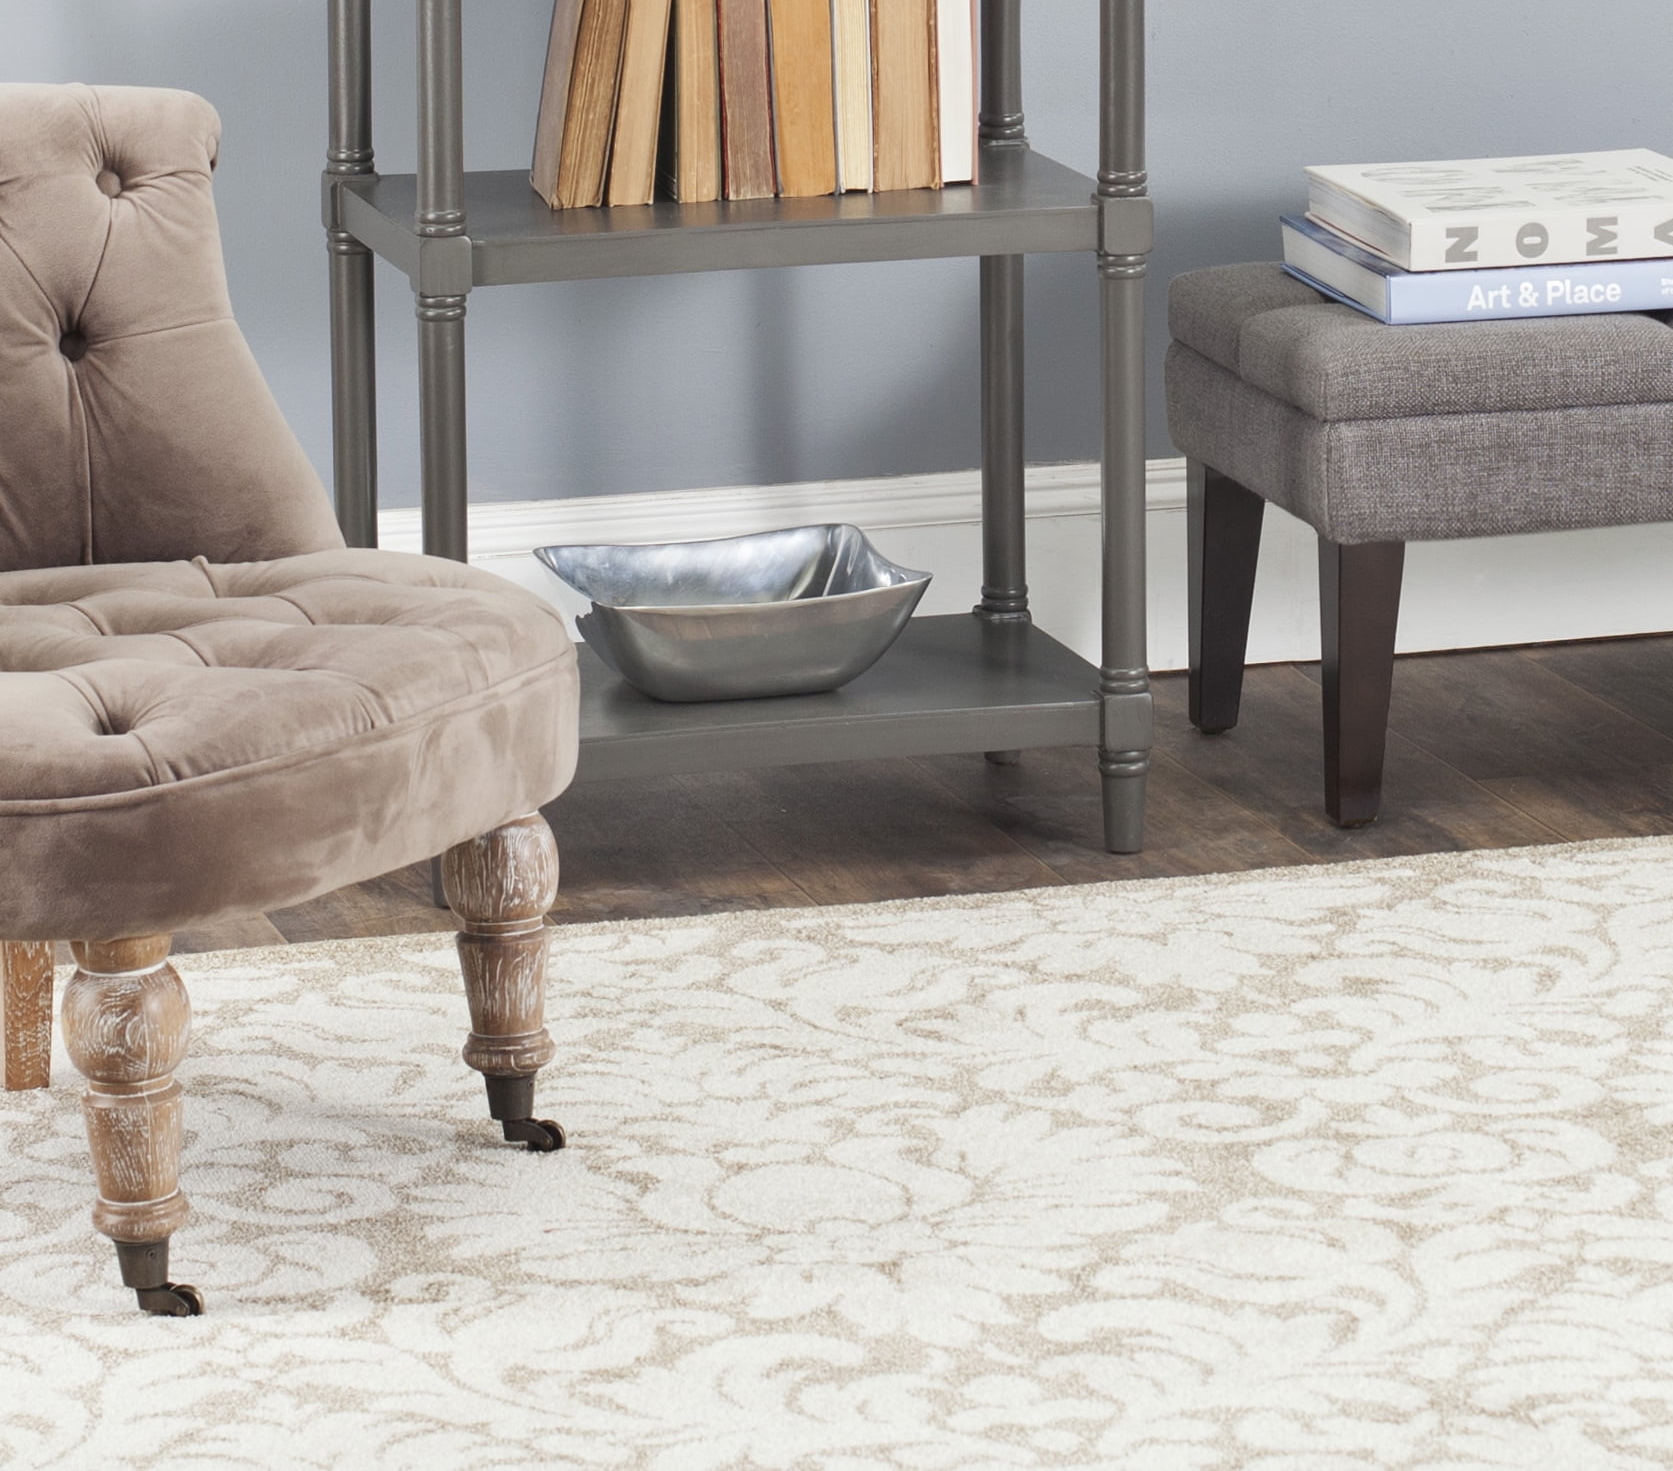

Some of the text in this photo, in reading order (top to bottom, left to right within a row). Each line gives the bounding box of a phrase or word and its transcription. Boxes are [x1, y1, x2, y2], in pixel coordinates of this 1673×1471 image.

[1466, 279, 1622, 311] Art & Place
